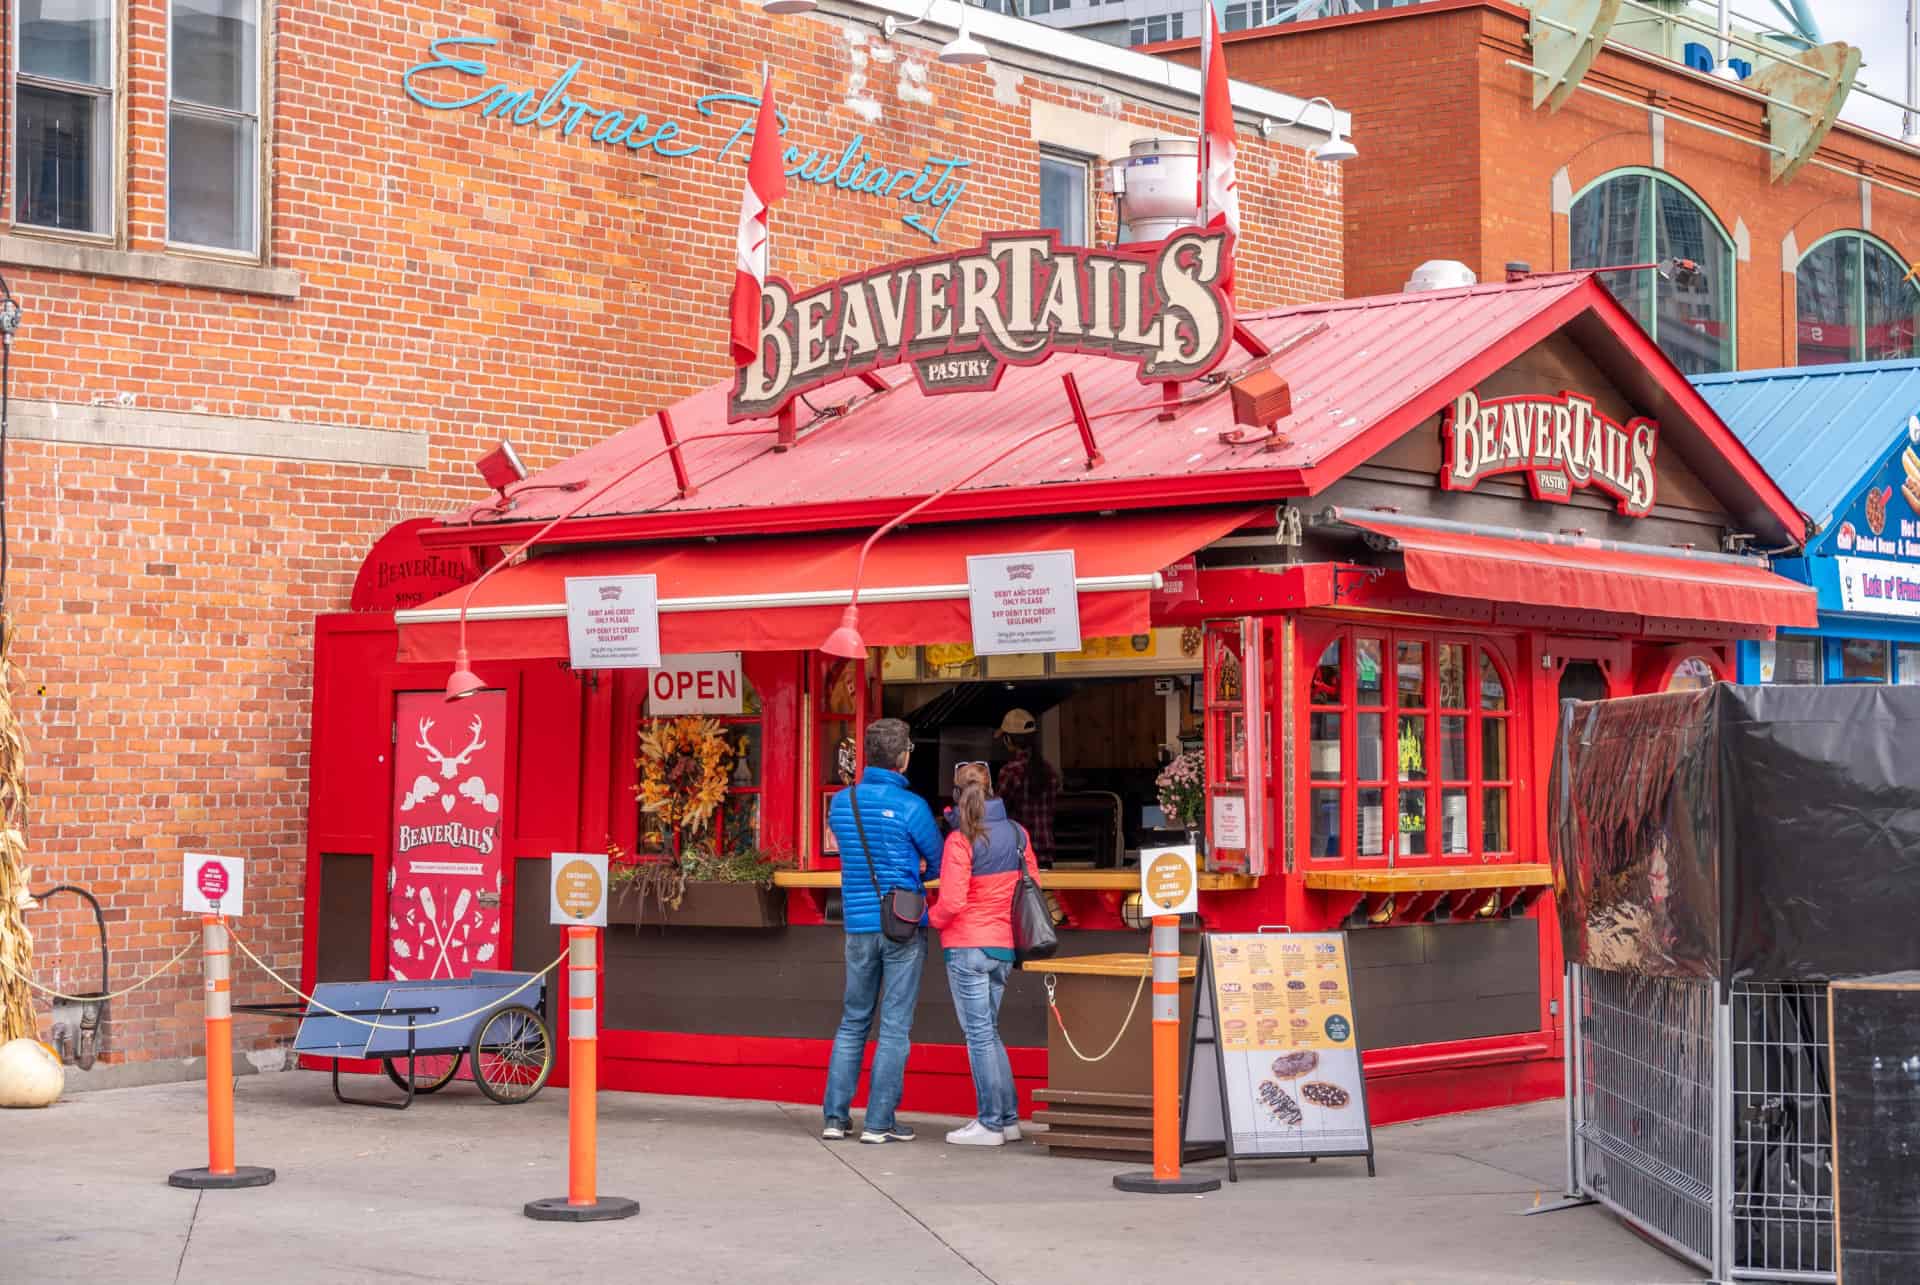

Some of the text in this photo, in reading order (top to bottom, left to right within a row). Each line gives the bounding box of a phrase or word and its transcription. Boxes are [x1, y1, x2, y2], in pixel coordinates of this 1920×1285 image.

[403, 36, 701, 157] Embrace
[696, 93, 972, 243] Pculiarity
[928, 359, 990, 381] PASTRY
[654, 670, 737, 700] OPEN
